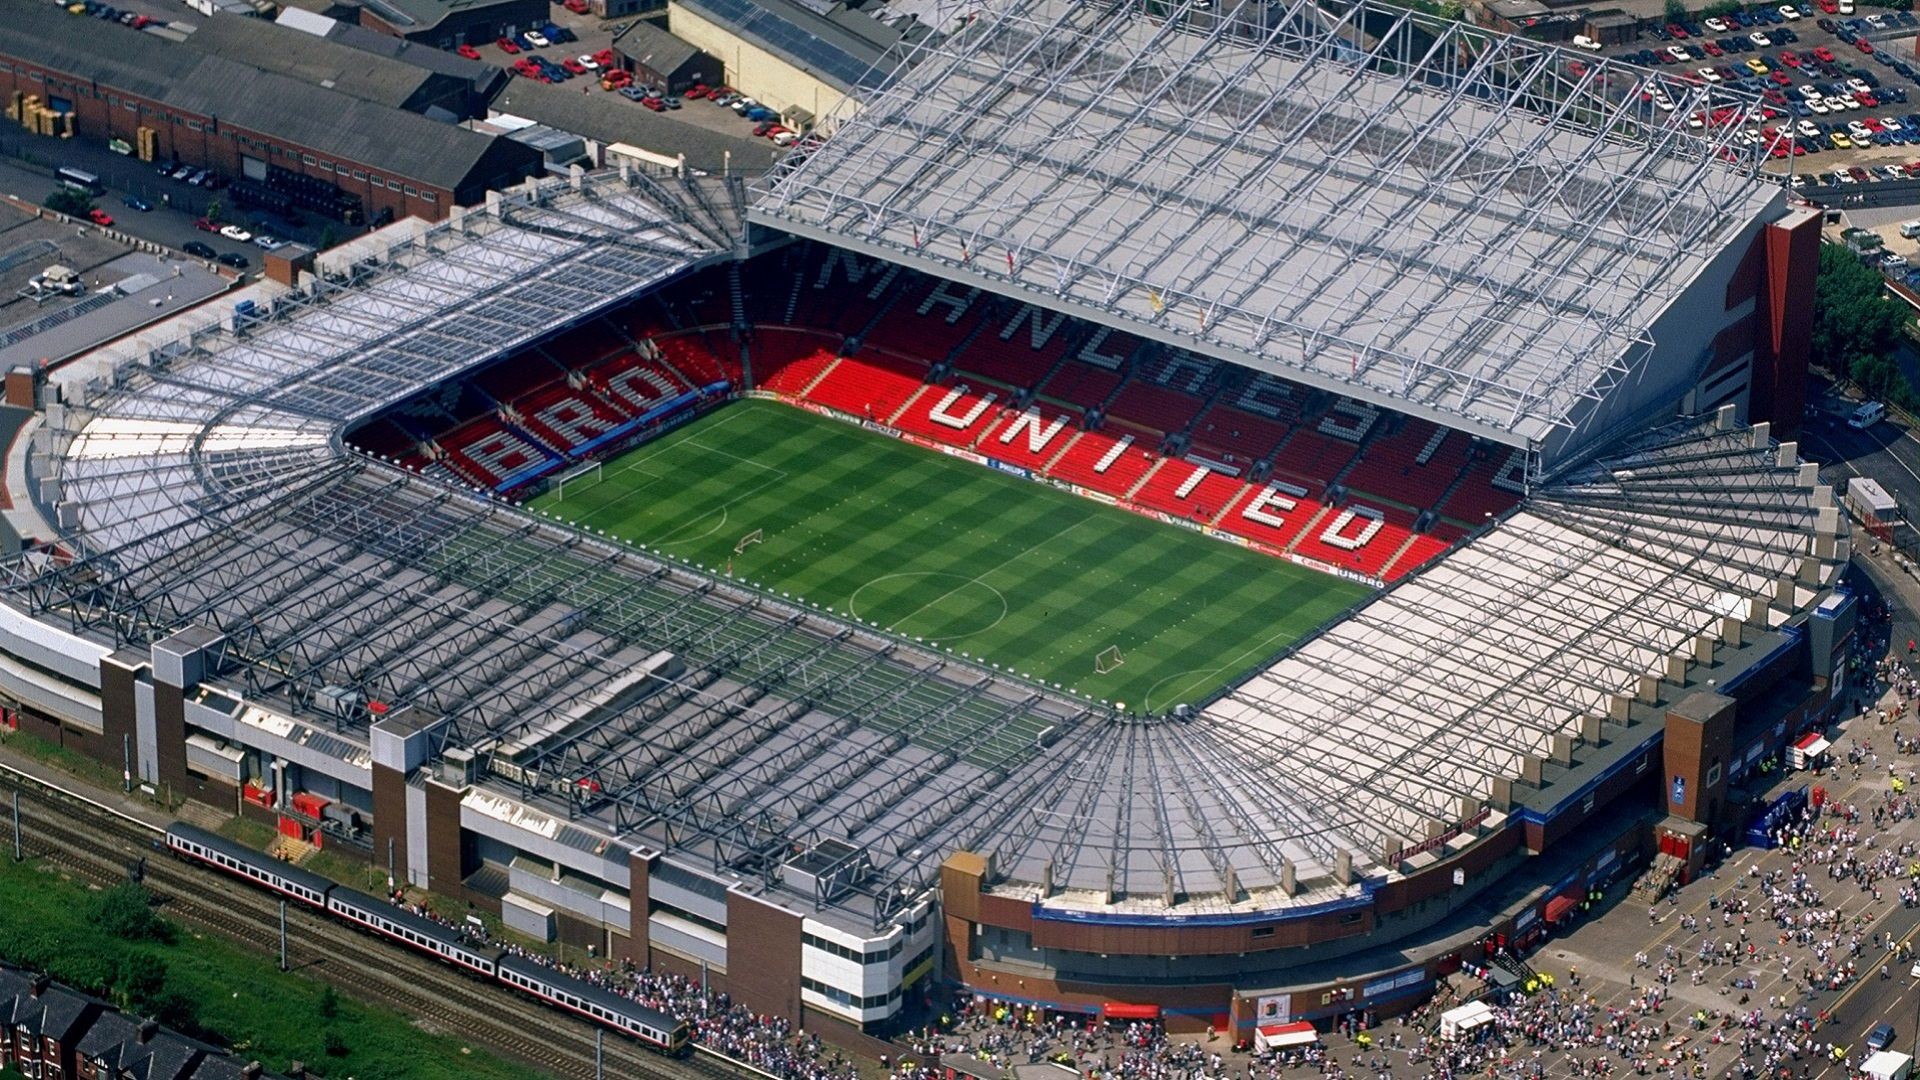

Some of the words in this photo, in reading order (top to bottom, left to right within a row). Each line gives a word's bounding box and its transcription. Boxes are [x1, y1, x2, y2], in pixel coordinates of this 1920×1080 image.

[929, 384, 1385, 550] UNITED
[1302, 558, 1330, 572] Canon
[1339, 569, 1385, 589] UMBRO
